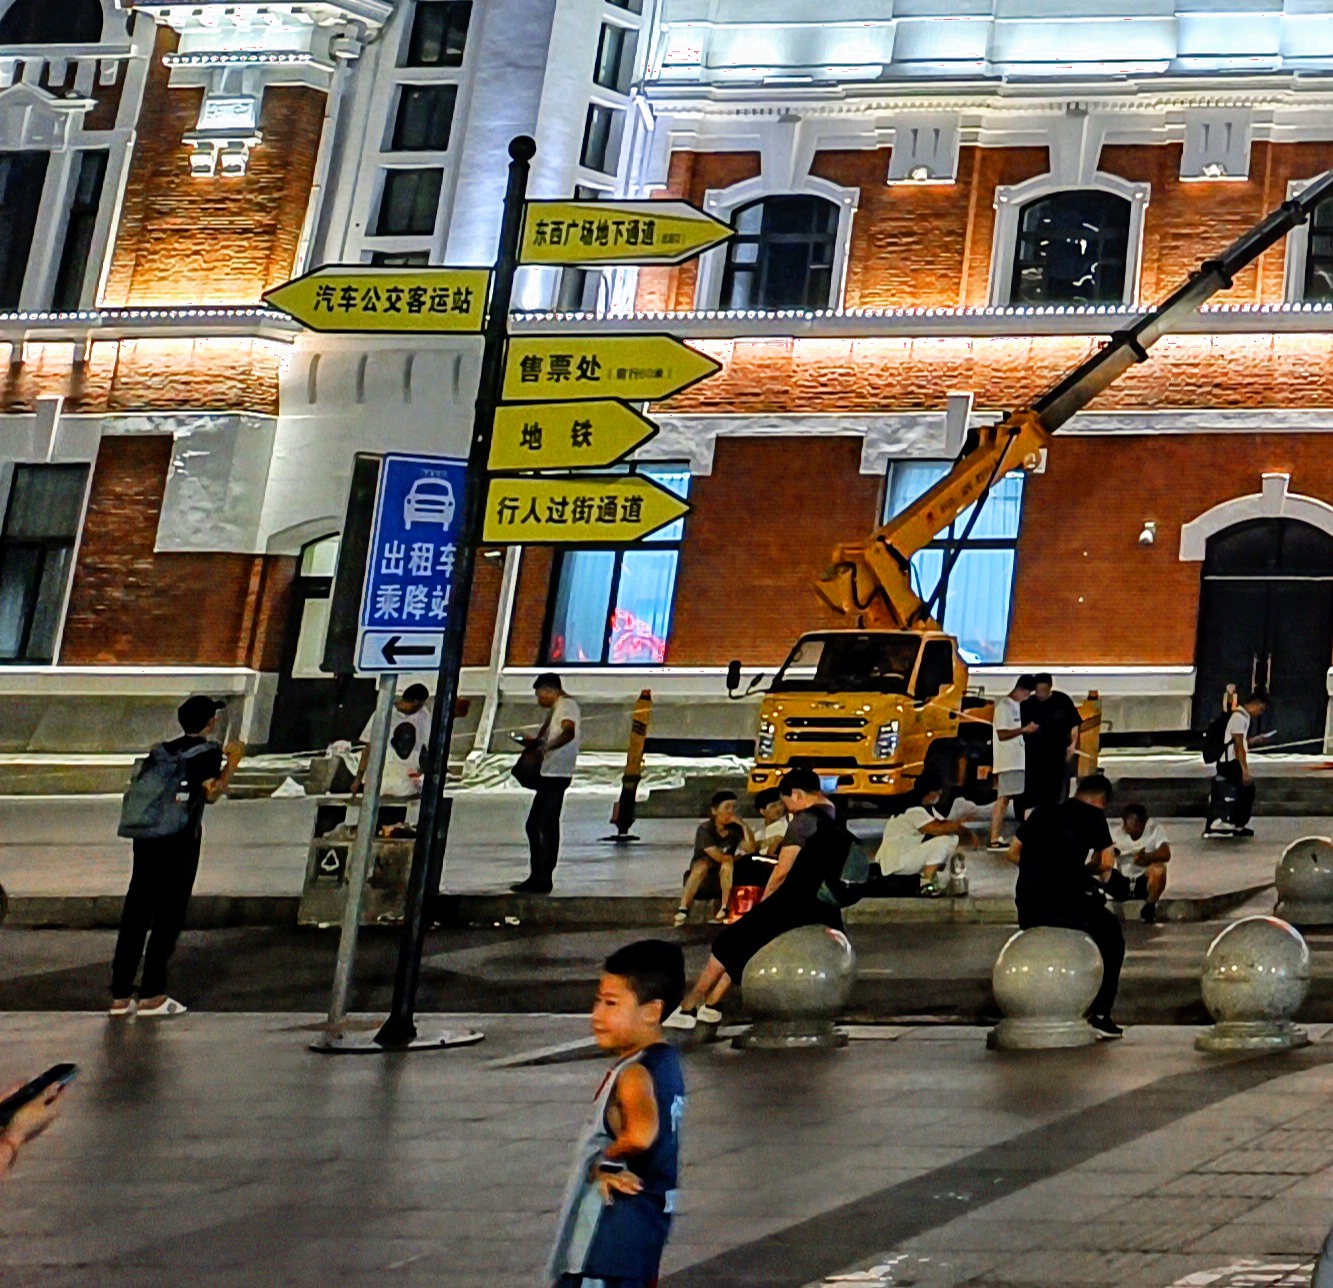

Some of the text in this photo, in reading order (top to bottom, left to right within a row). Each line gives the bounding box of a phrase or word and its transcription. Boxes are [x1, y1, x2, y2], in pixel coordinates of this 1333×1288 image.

[533, 219, 656, 246] 东西广场地下通道
[313, 284, 474, 314] 汽车公交客运站
[519, 354, 602, 383] 售票处
[496, 495, 644, 525] 行人过街通道
[380, 541, 458, 578] 出租车
